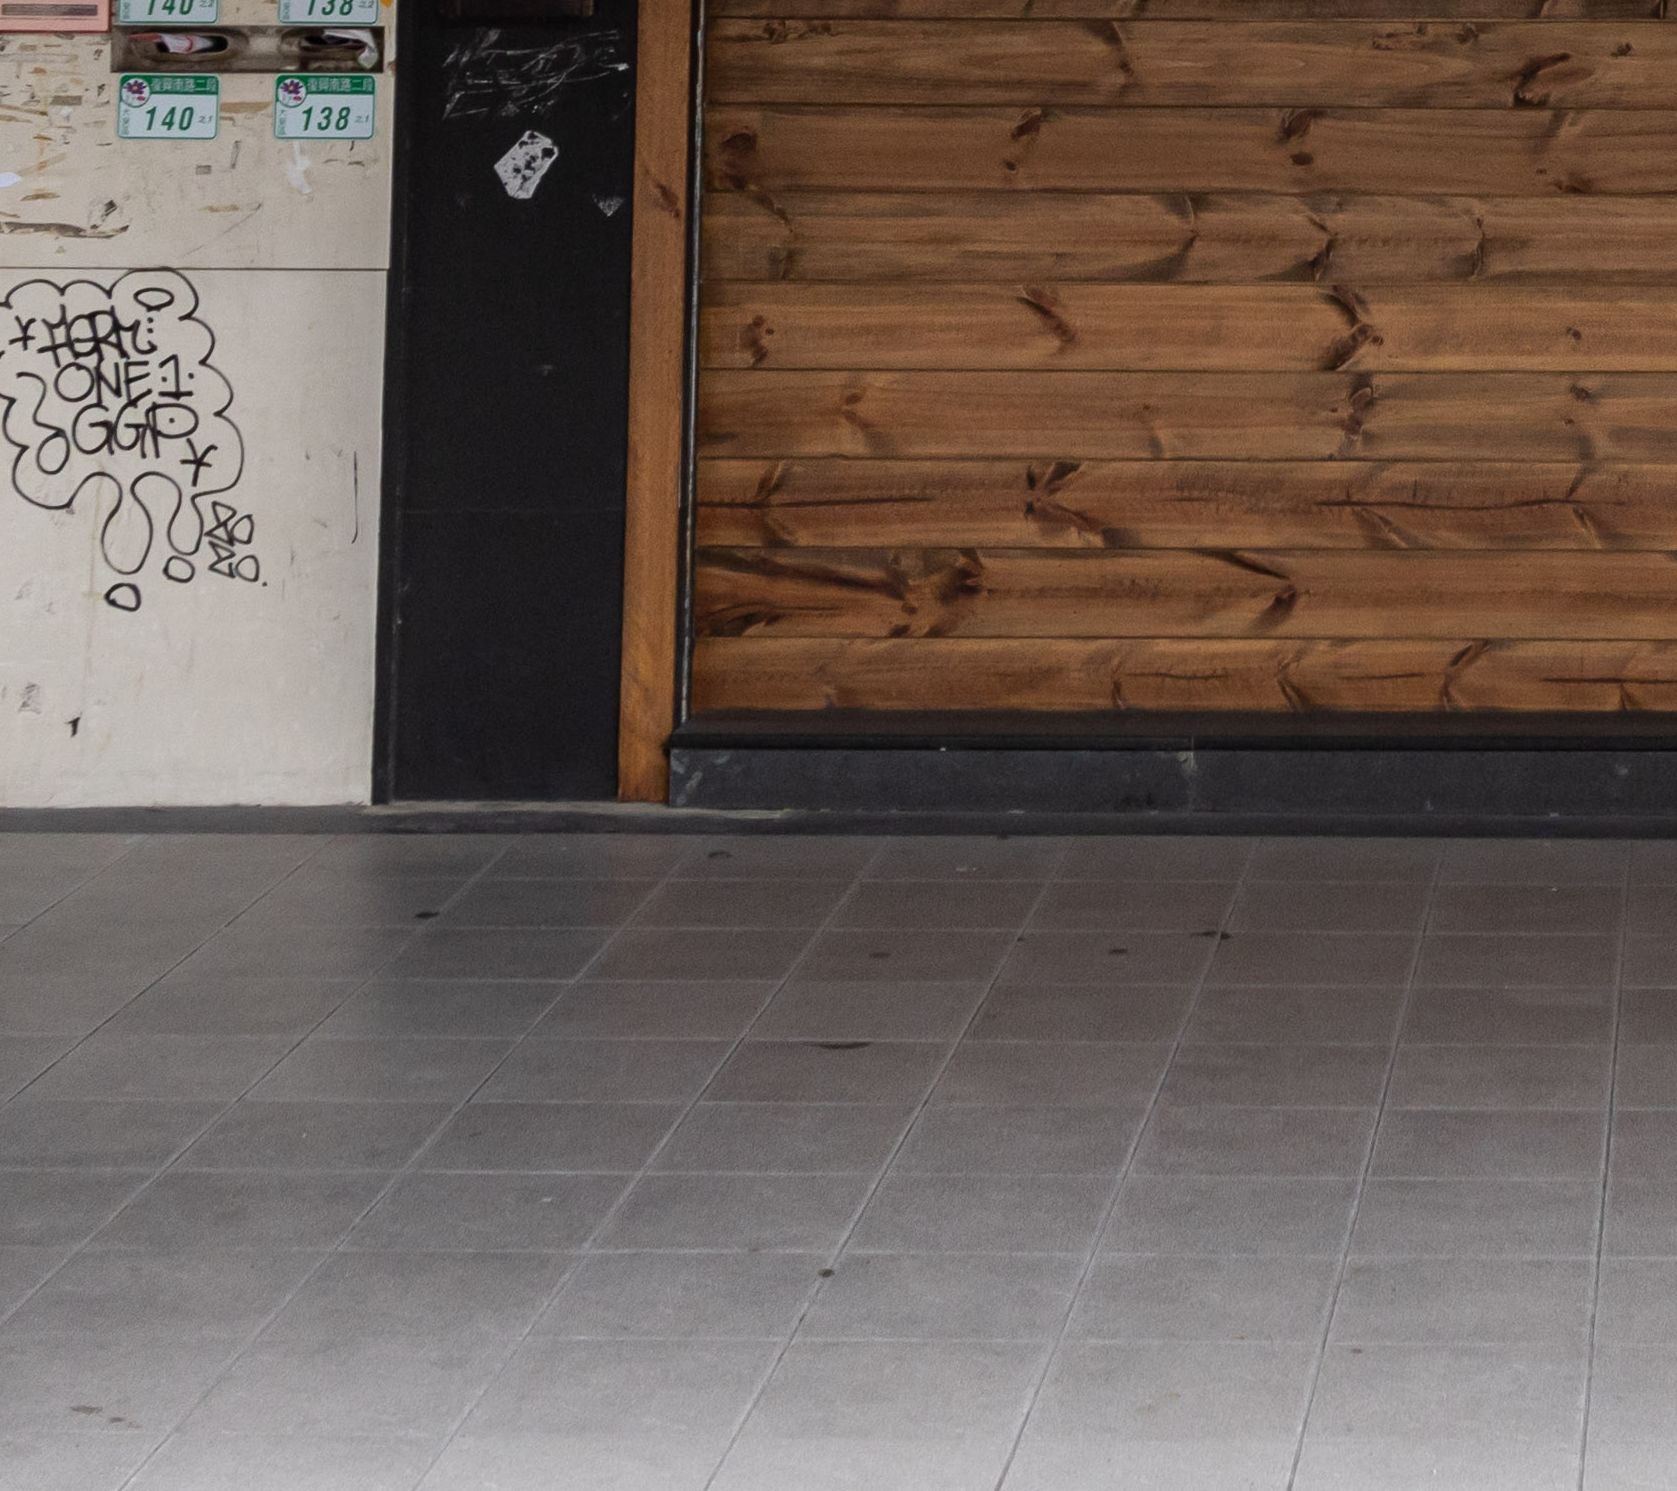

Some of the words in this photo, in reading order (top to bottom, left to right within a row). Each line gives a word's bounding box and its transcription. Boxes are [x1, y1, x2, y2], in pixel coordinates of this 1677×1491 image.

[150, 77, 217, 92] 復興南路二段
[306, 78, 374, 93] 復興南路二段
[145, 106, 194, 131] 140
[301, 106, 351, 131] 138
